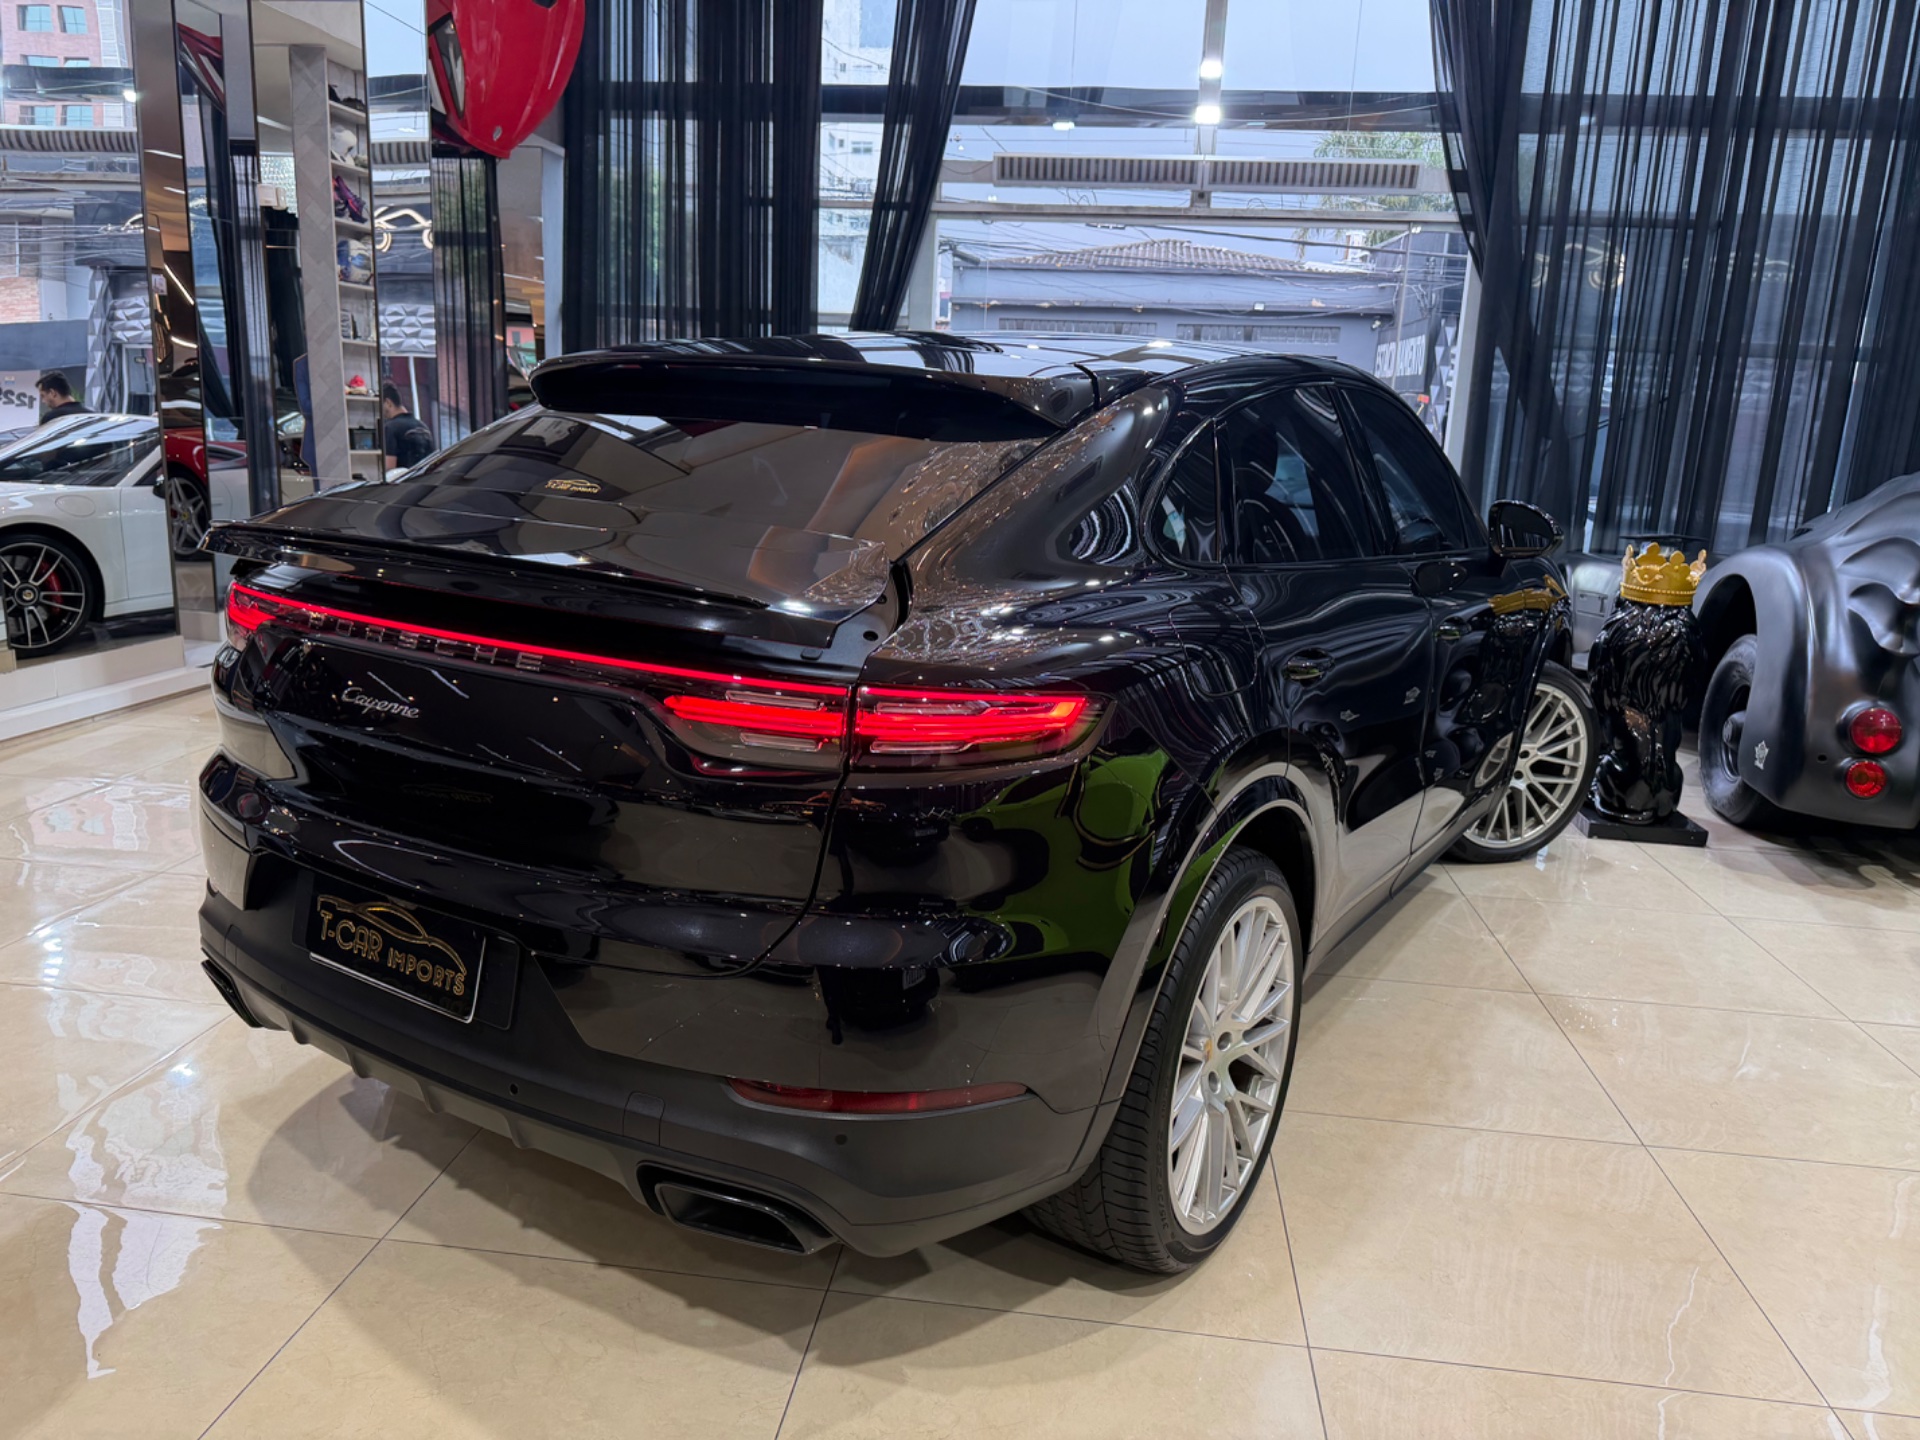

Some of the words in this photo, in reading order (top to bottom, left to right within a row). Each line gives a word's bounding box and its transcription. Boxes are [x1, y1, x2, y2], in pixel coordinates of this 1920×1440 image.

[308, 609, 543, 672] PORSCHE
[341, 687, 420, 719] Cayenne
[320, 910, 383, 962] T-CAR
[387, 947, 465, 996] IMPORTS
